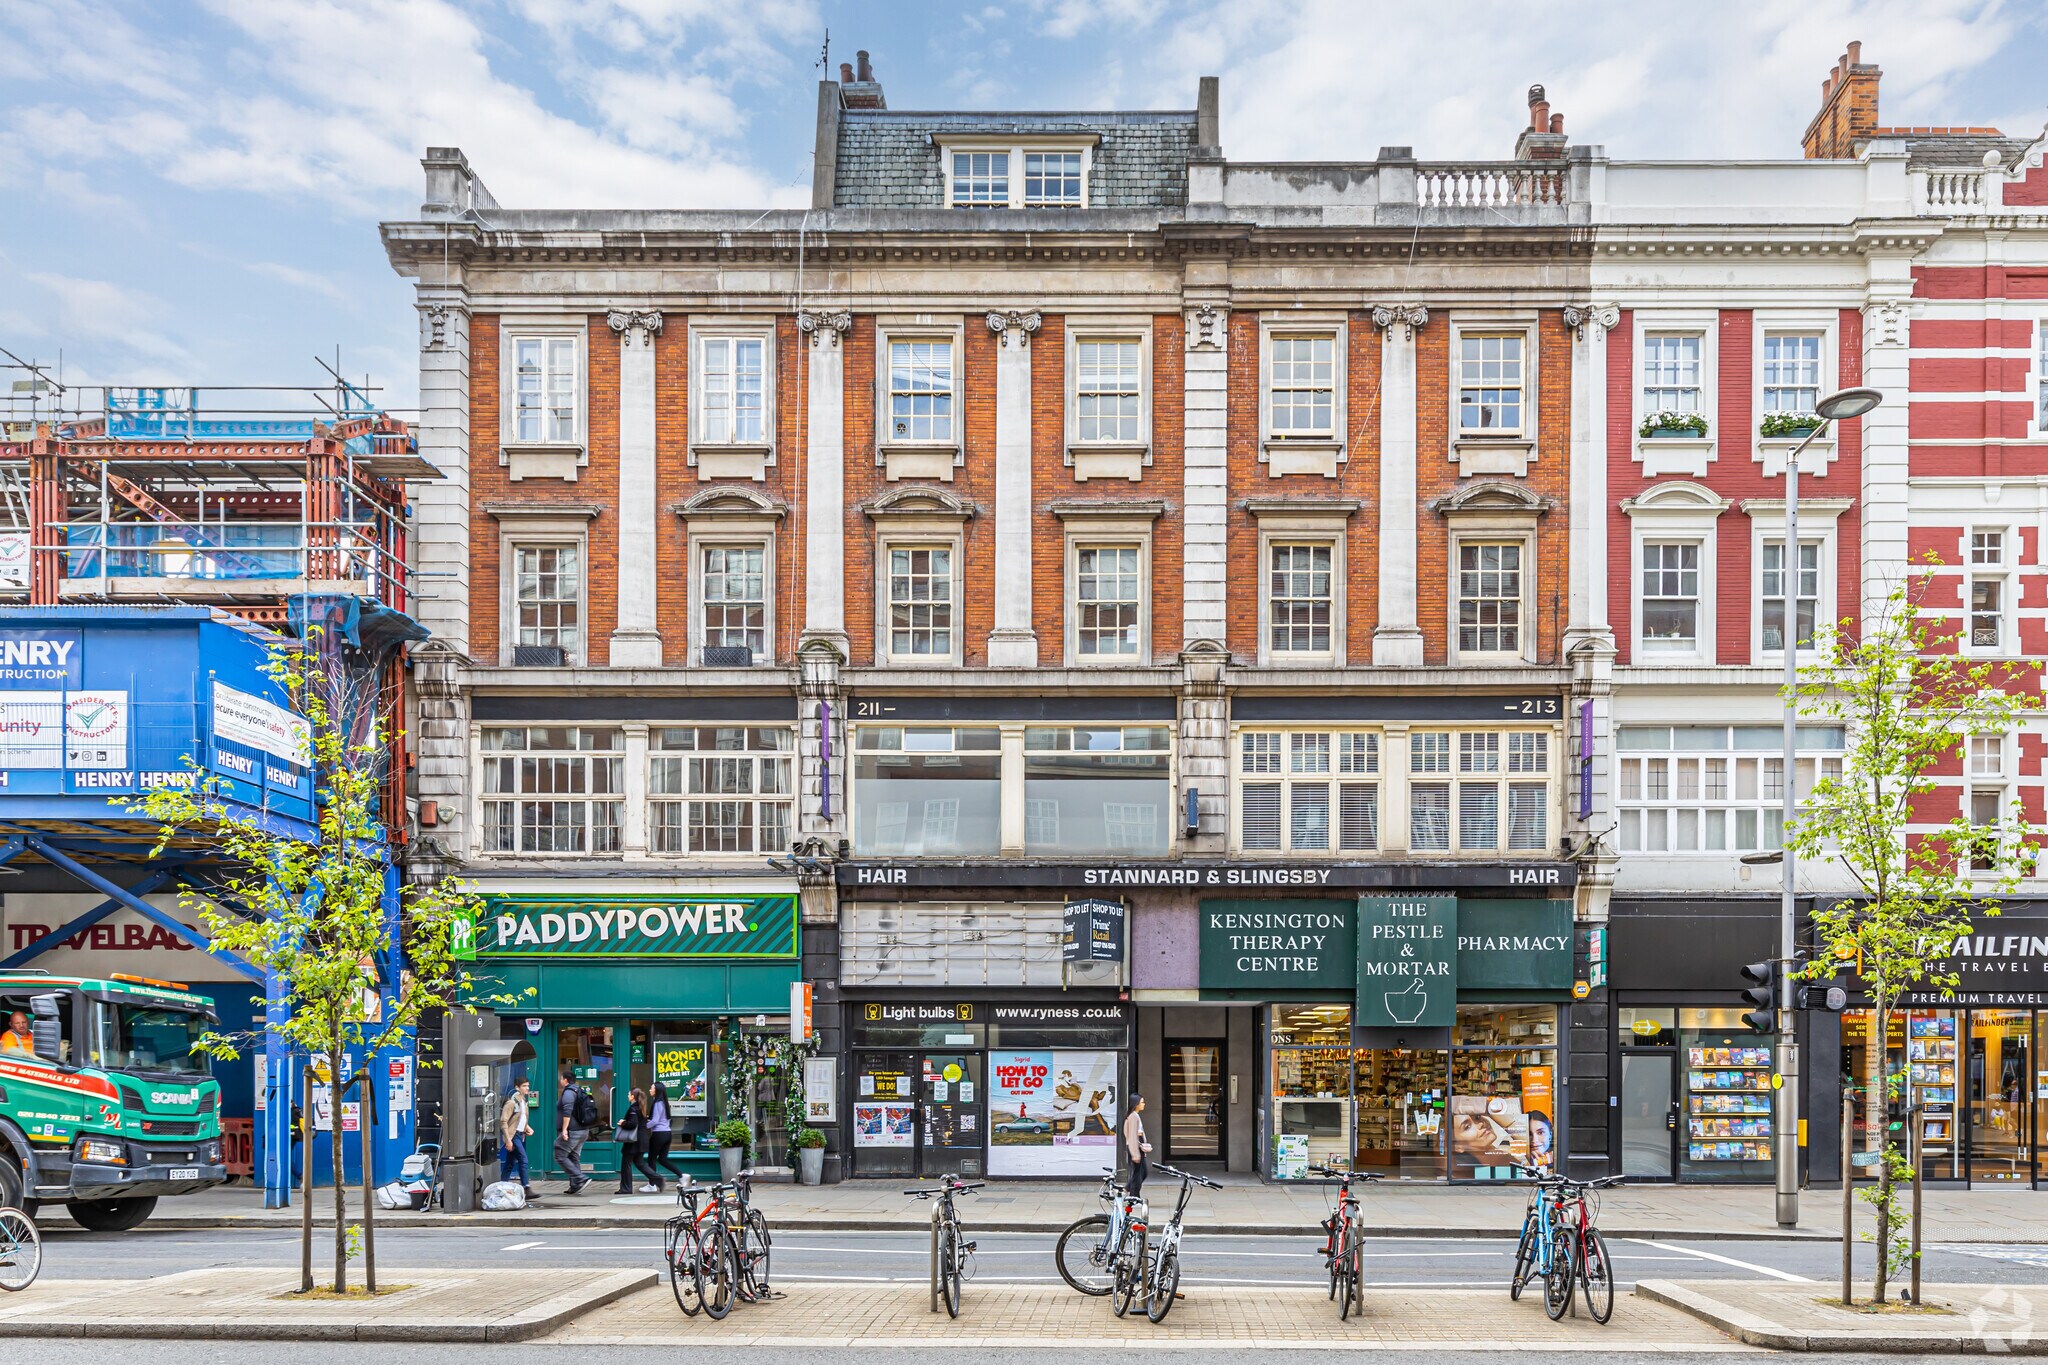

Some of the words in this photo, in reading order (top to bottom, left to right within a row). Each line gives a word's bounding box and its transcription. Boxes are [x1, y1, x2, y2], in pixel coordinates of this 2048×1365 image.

[0, 641, 74, 665] NRY
[66, 696, 119, 716] ONSIDERATE
[215, 703, 234, 717] ecure
[66, 719, 118, 738] ONSTRUCTORS
[218, 750, 253, 774] HENRY
[75, 772, 133, 787] HENRY
[267, 766, 298, 789] HENRY
[858, 869, 907, 883] HAIR
[1084, 869, 1200, 884] STANNARD
[1206, 870, 1220, 884] &
[1227, 869, 1331, 884] SLINGSBY
[1510, 870, 1559, 883] HAIR
[1081, 903, 1090, 914] LET
[1092, 903, 1108, 914] SHOP
[1109, 905, 1116, 915] TO
[1116, 907, 1124, 917] LET
[1388, 903, 1427, 917] THE
[1210, 913, 1345, 929] KENSINGTON
[1372, 925, 1443, 939] PESTLE
[1229, 935, 1326, 950] THERAPY
[1457, 936, 1569, 951] PHARMACY
[1400, 943, 1415, 957] &
[1236, 956, 1319, 972] CENTRE
[1366, 962, 1450, 976] MORTAR
[1925, 962, 1946, 972] HE
[1961, 962, 2029, 972] TRAVEL
[1911, 993, 1979, 1003] PREMIUM
[1988, 993, 2042, 1003] TRAVEL
[882, 1006, 916, 1021] Light
[918, 1006, 955, 1019] bulbs
[995, 1007, 1079, 1020] www.ryness
[1082, 1006, 1122, 1018] .co.uk
[657, 1048, 703, 1063] MONEY
[657, 1060, 690, 1073] BACK
[996, 1065, 1029, 1077] HOW
[1031, 1065, 1048, 1077] TO
[17, 1068, 63, 1082] MATERIALS
[63, 1077, 80, 1085] LTD
[1001, 1077, 1020, 1088] LET
[1023, 1077, 1043, 1088] GO
[876, 1082, 885, 1090] WE
[886, 1082, 896, 1090] DO!
[150, 1091, 193, 1105] SCANIA
